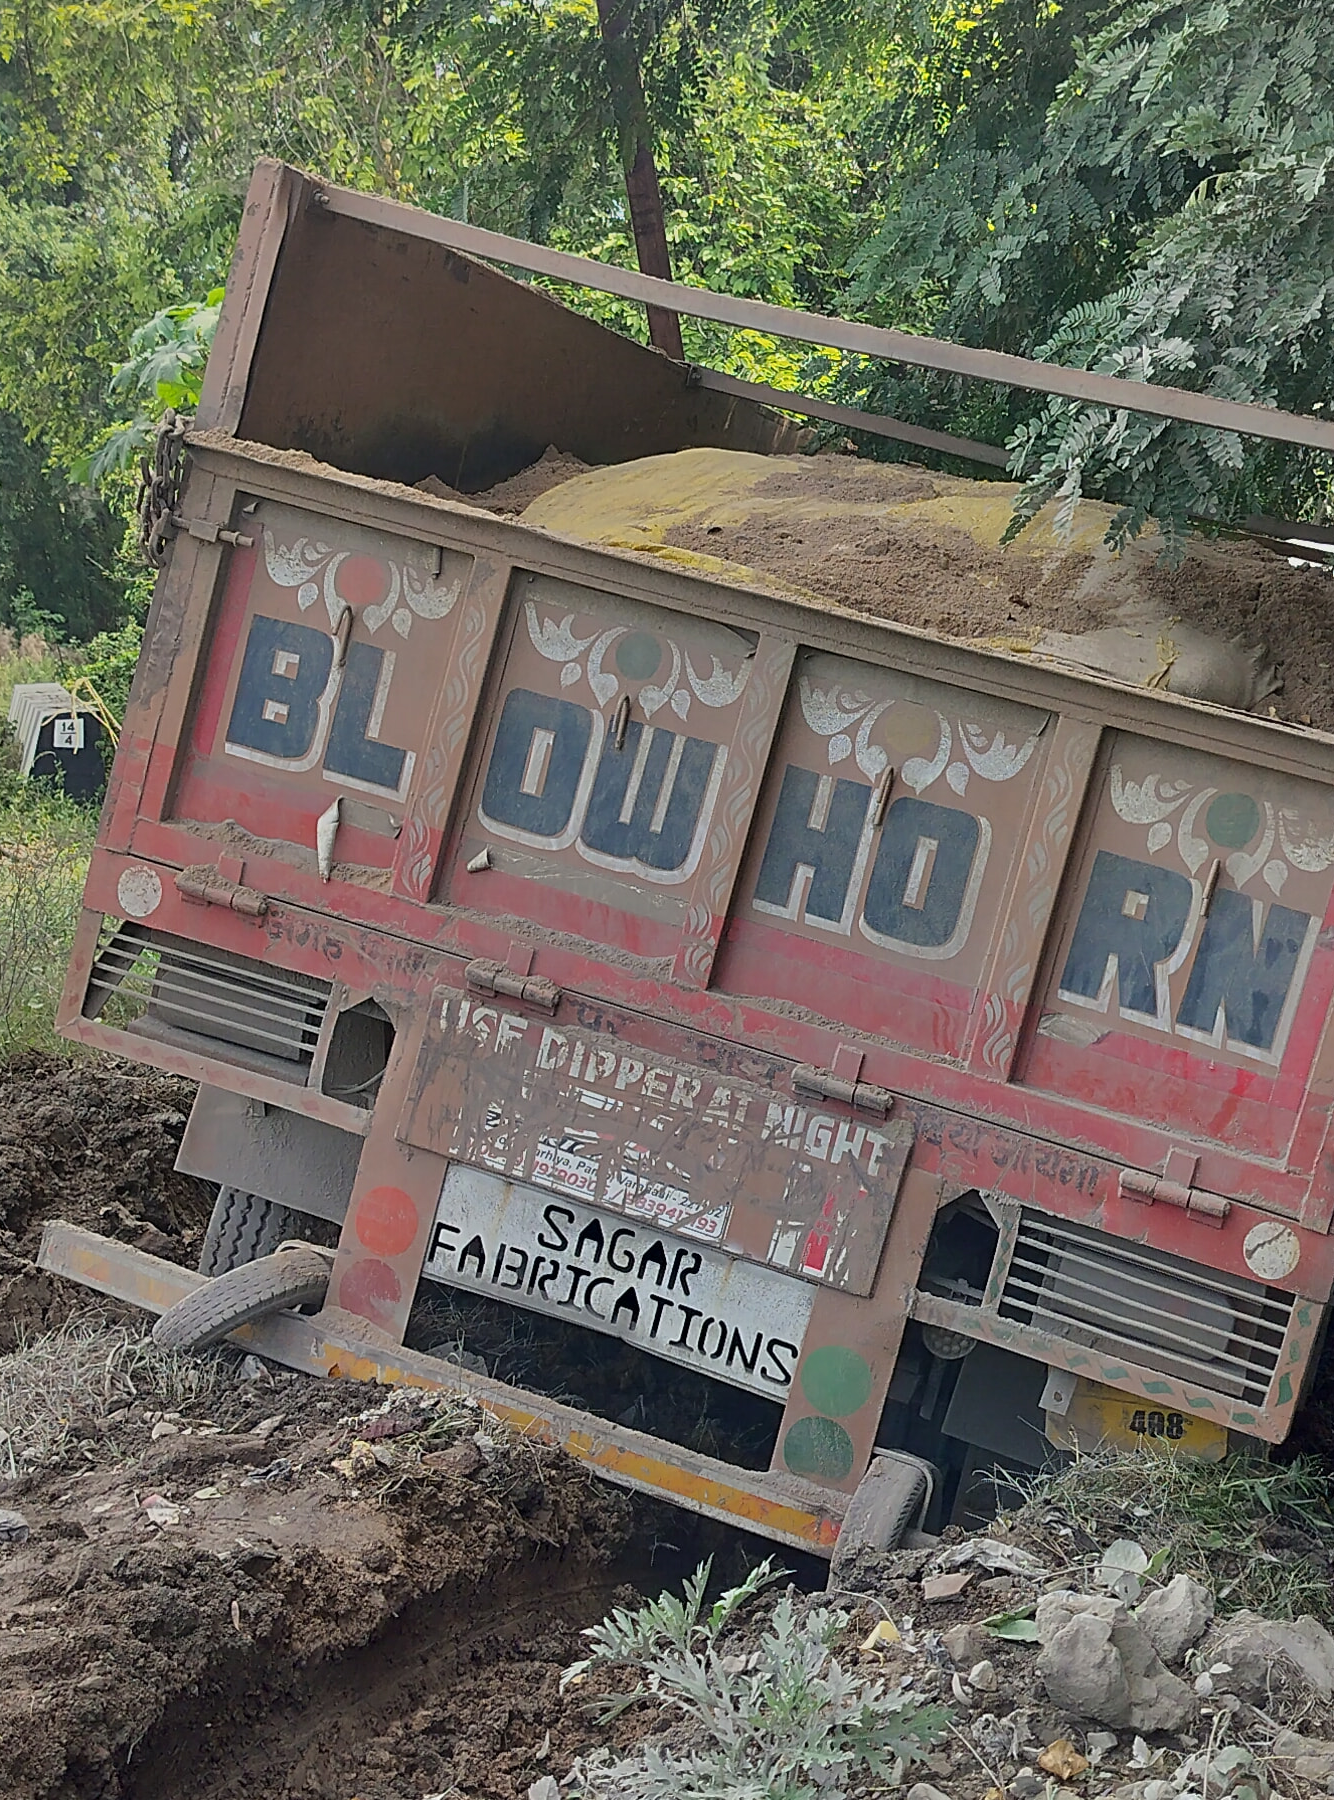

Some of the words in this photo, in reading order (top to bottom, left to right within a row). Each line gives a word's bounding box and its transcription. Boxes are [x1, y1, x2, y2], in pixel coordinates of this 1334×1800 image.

[61, 721, 75, 732] 14
[64, 734, 72, 745] 4
[224, 613, 417, 803] BL
[477, 687, 729, 885] OW
[751, 764, 992, 961] HO
[1056, 850, 1323, 1068] RN
[535, 1026, 701, 1108] DIPPER
[761, 1102, 891, 1177] NIGHT
[427, 1221, 799, 1387] FABRICATIONS
[537, 1204, 703, 1297] SAGAR
